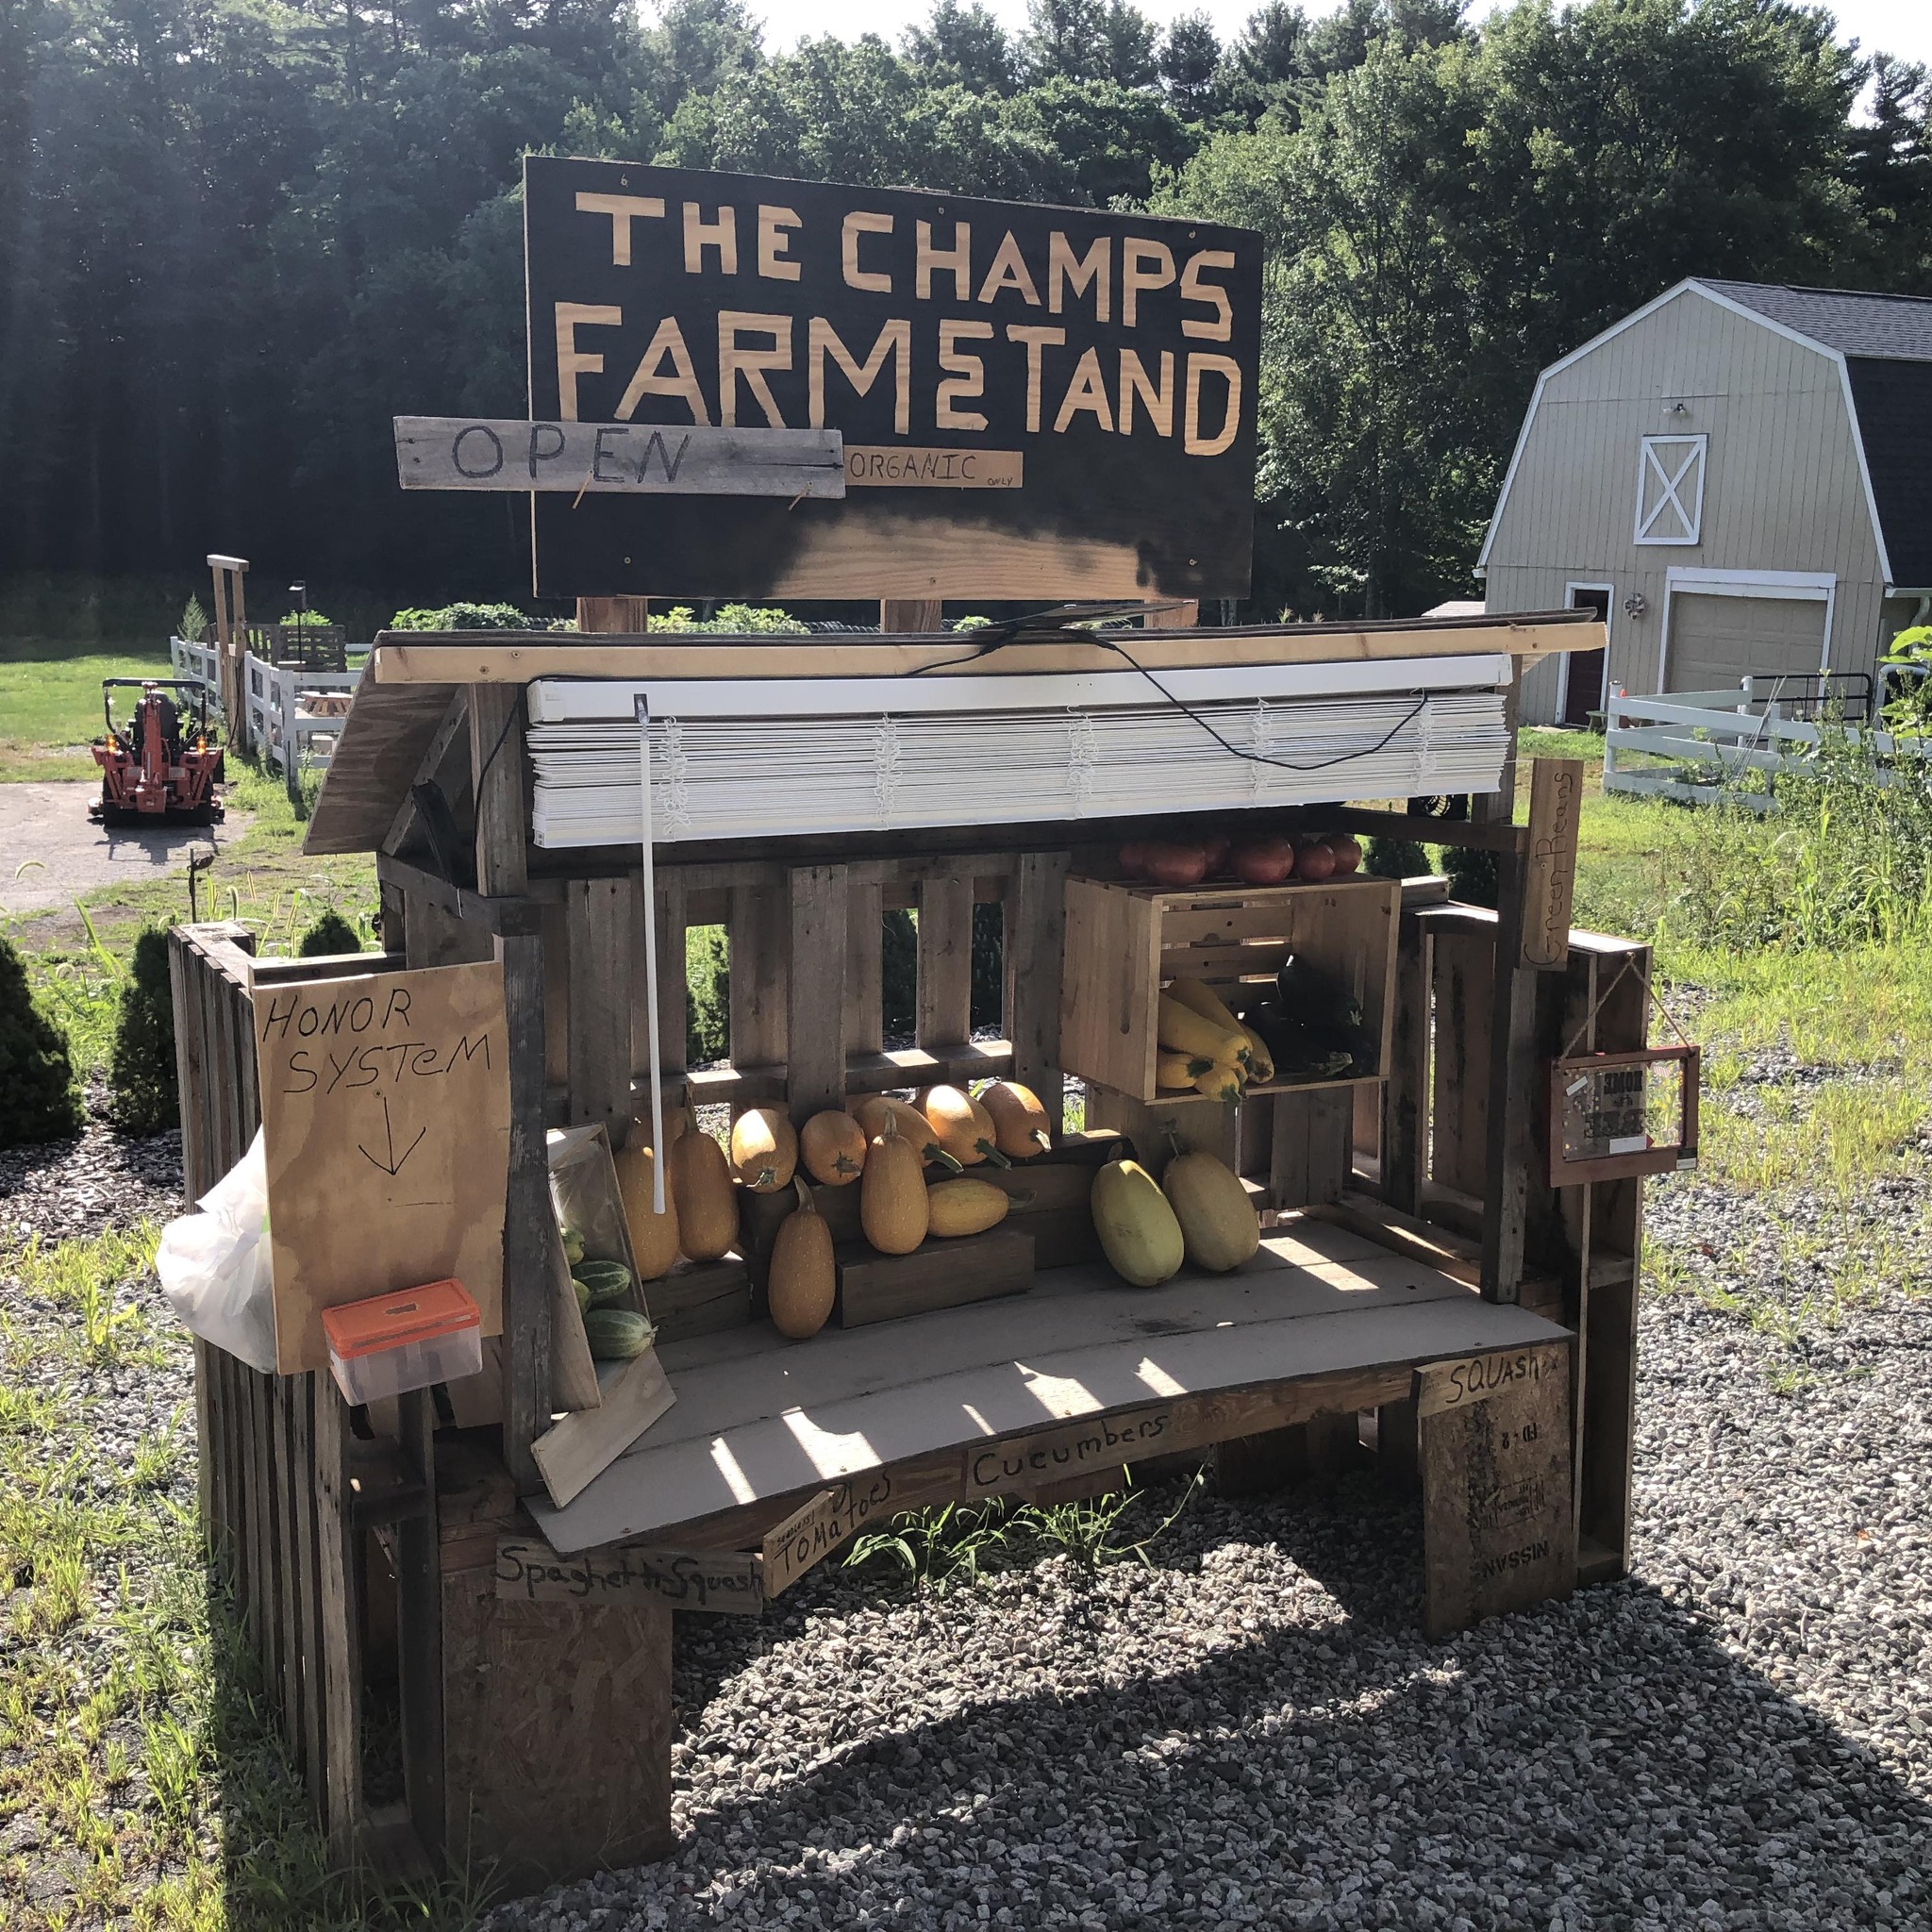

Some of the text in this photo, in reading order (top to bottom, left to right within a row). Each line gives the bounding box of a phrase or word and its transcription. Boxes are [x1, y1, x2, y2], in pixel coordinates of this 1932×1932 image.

[575, 192, 1237, 343] THE CHAMPS
[452, 424, 692, 485] OPEN
[850, 452, 1013, 487] ORGANIC ONLY
[1523, 772, 1574, 966] Green Beans
[262, 988, 411, 1042] HONOR
[973, 1414, 1169, 1487] Cucumbers
[660, 1557, 763, 1605] Squash
[1481, 1540, 1550, 1579] NISSAN
